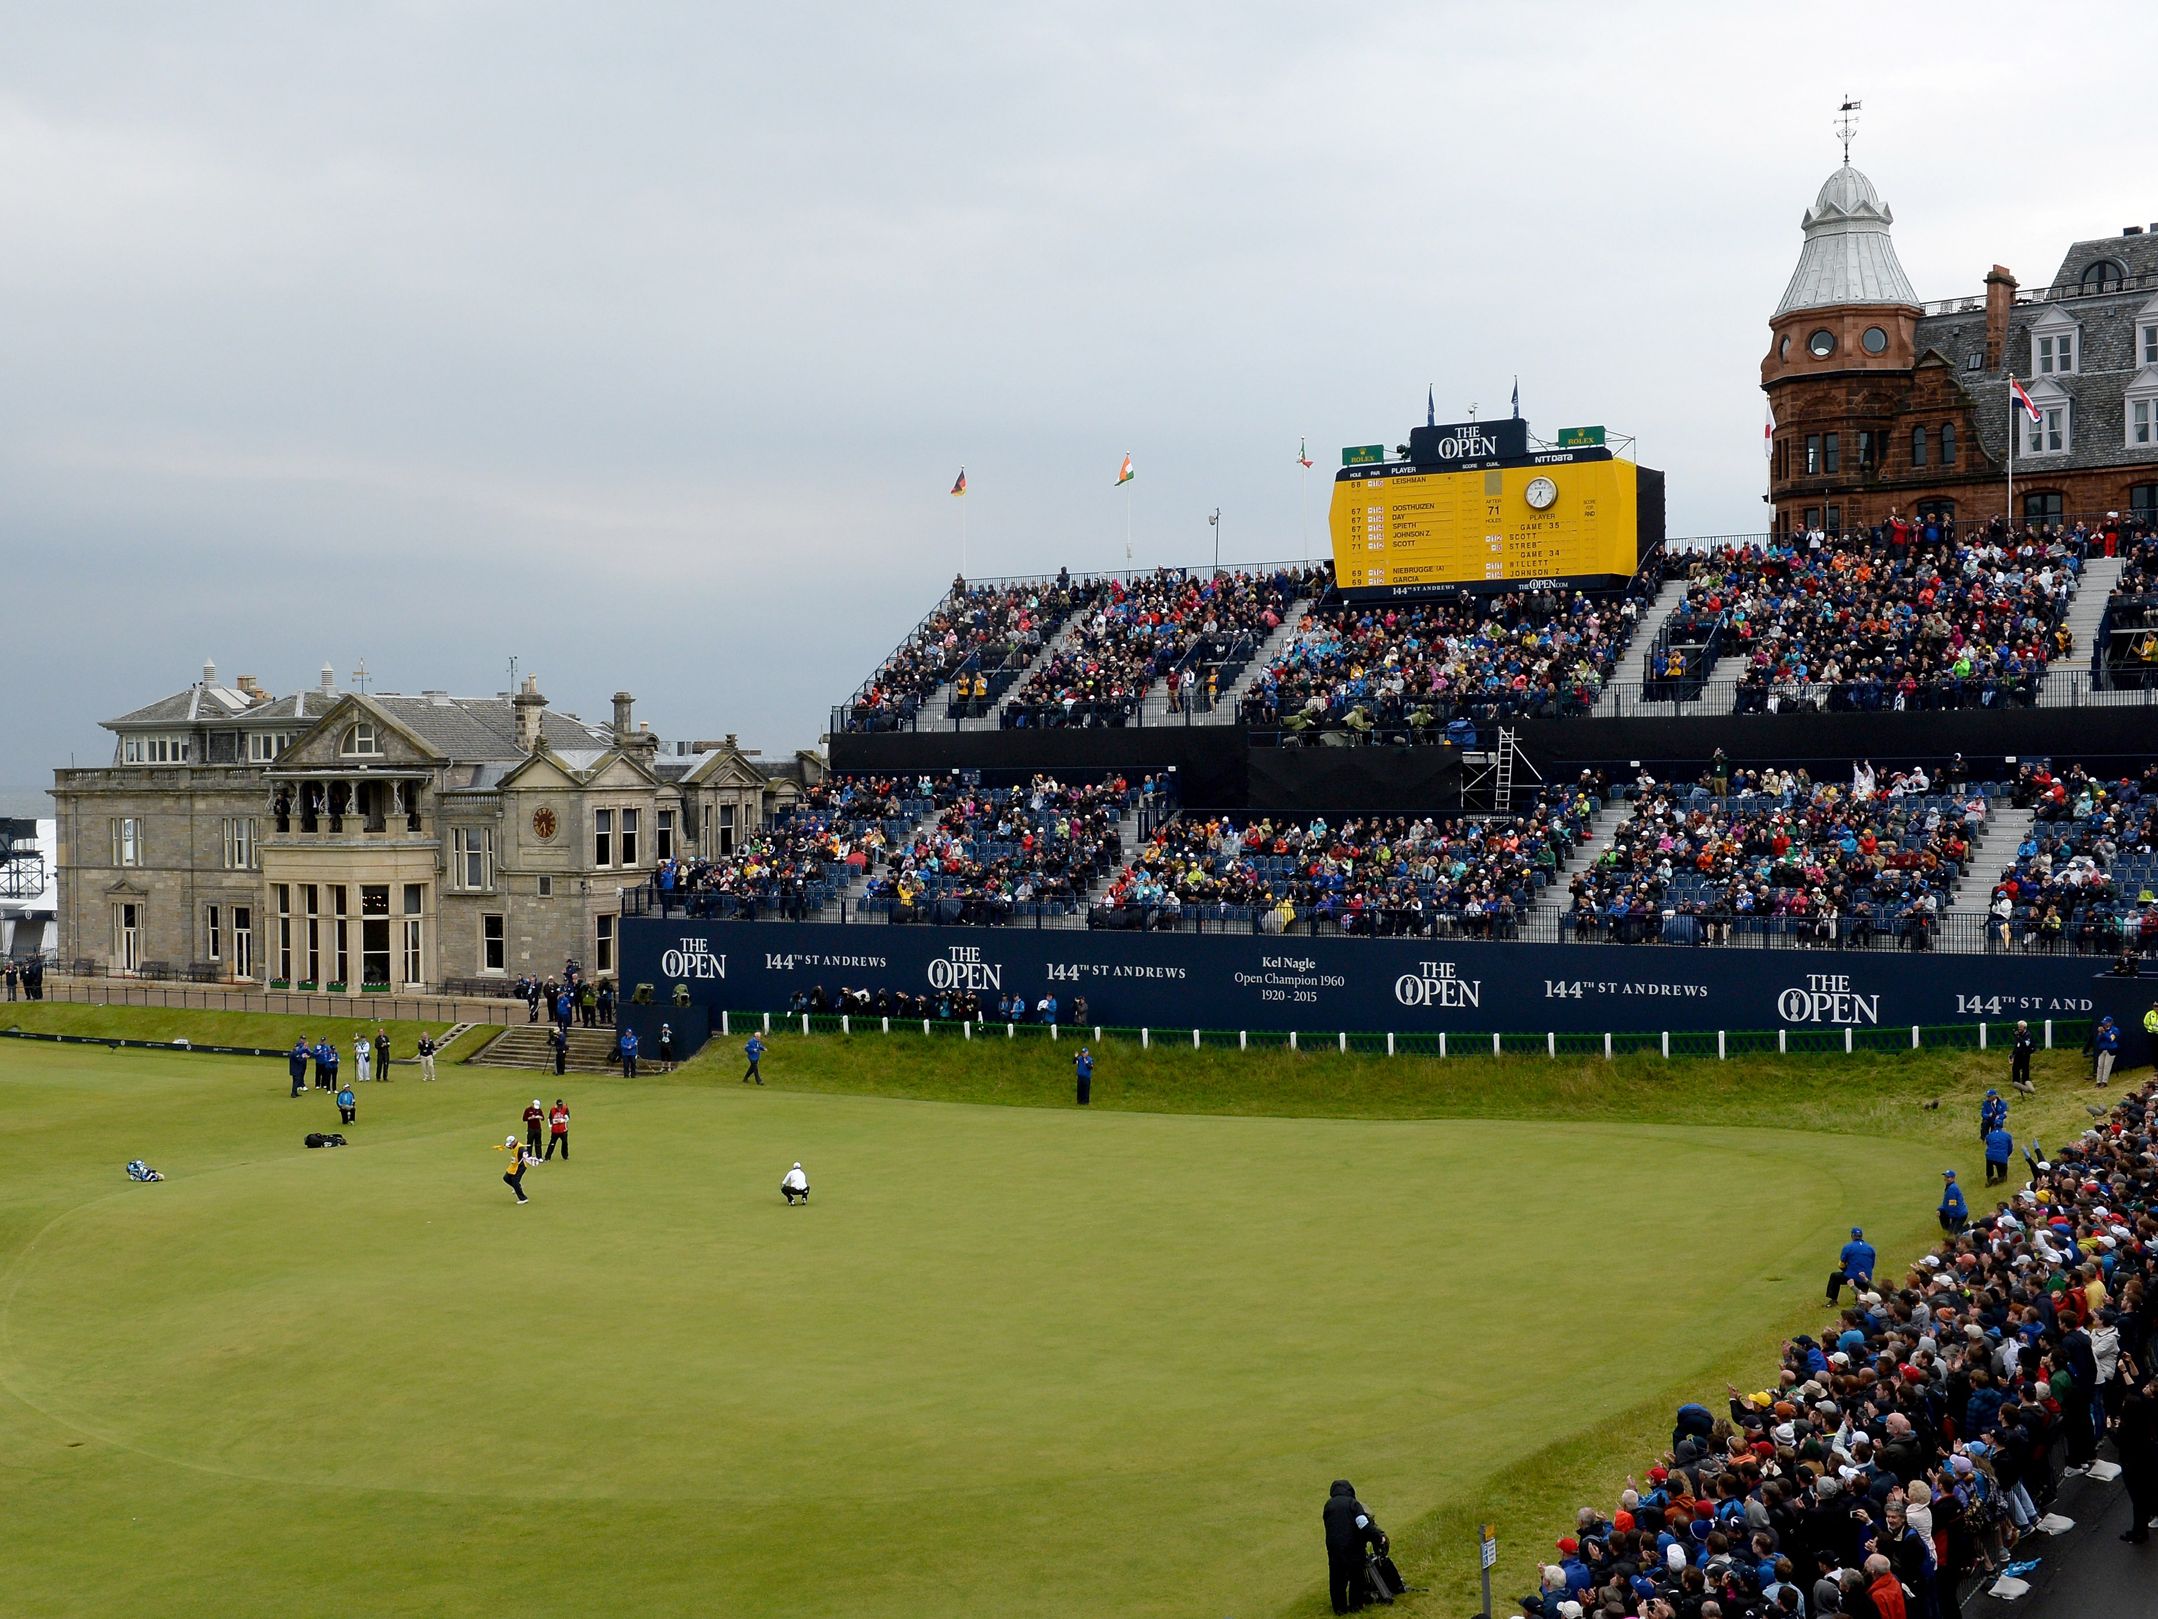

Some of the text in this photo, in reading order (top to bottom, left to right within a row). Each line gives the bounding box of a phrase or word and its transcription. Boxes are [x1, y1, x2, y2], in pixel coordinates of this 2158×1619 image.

[1455, 426, 1480, 438] THE
[1438, 436, 1497, 459] OPEN
[1568, 437, 1595, 445] ROLEX
[1351, 455, 1376, 463] ROLEX
[1535, 455, 1551, 463] NTT
[1391, 466, 1416, 474] PLAYER
[1392, 477, 1426, 485] LEISHMAN
[1392, 503, 1435, 511] OOSTHUIZEN
[1488, 506, 1500, 515] 71
[1392, 531, 1424, 539] JOHNSON
[1392, 566, 1433, 574] NIEBRUGGE
[1509, 569, 1549, 577] JOHNSON
[680, 938, 708, 953] THE
[765, 953, 887, 970] 144TH ST ANDREWS
[949, 946, 981, 962] THE
[661, 949, 727, 979] OPEN
[1046, 963, 1187, 981] 144TH ST ANDREWS
[1262, 956, 1316, 972] Kel Nagle
[1419, 961, 1456, 979] THE
[927, 959, 1002, 990] OPEN
[1234, 972, 1345, 988] Open Champion 1960
[1395, 974, 1481, 1008] OPEN
[1544, 980, 1708, 999] 144TH ST ANDREWS
[1806, 974, 1850, 992] THE
[1262, 989, 1285, 1001] 1920
[1293, 990, 1317, 1002] 2015
[1777, 987, 1880, 1024] OPEN
[1956, 994, 2093, 1015] 144TH ST AND
